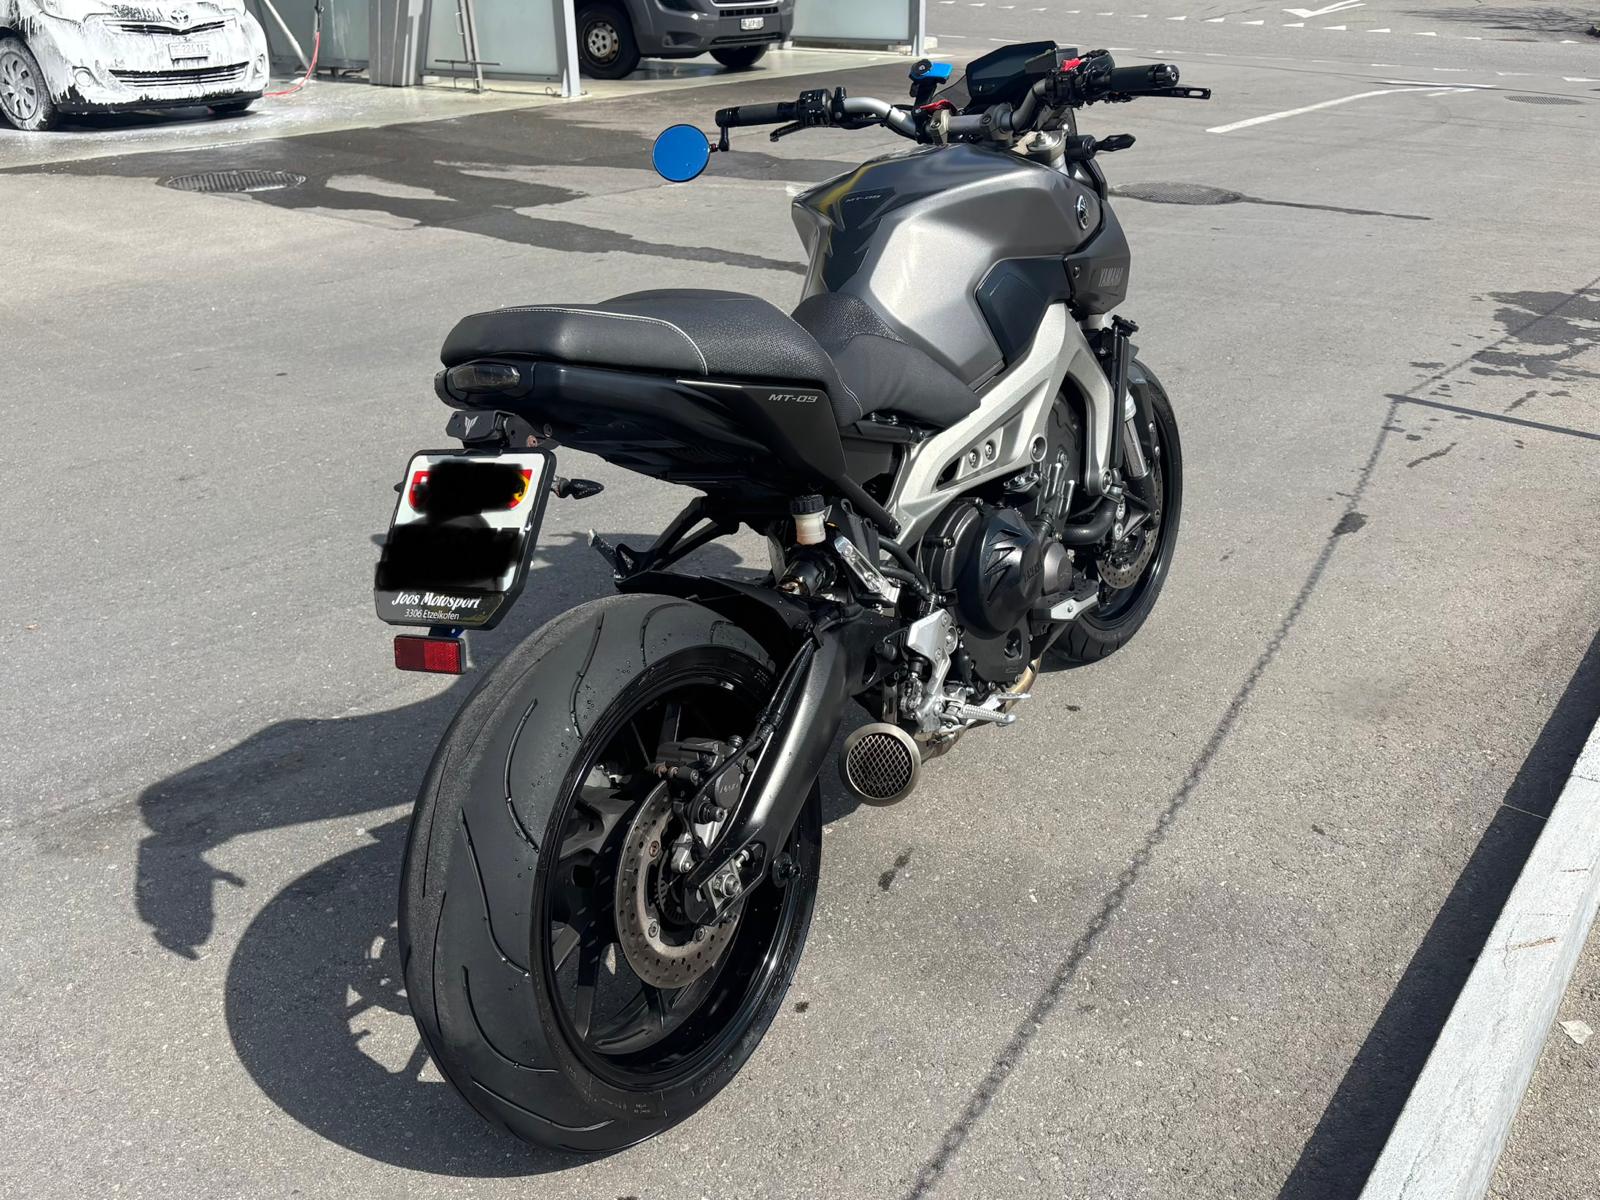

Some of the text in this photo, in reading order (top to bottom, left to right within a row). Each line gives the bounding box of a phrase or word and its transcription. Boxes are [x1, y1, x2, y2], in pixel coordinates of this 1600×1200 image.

[768, 393, 818, 403] MT-09
[391, 592, 482, 611] Joos Motosport
[404, 608, 460, 621] 3306 Etzelkofen
